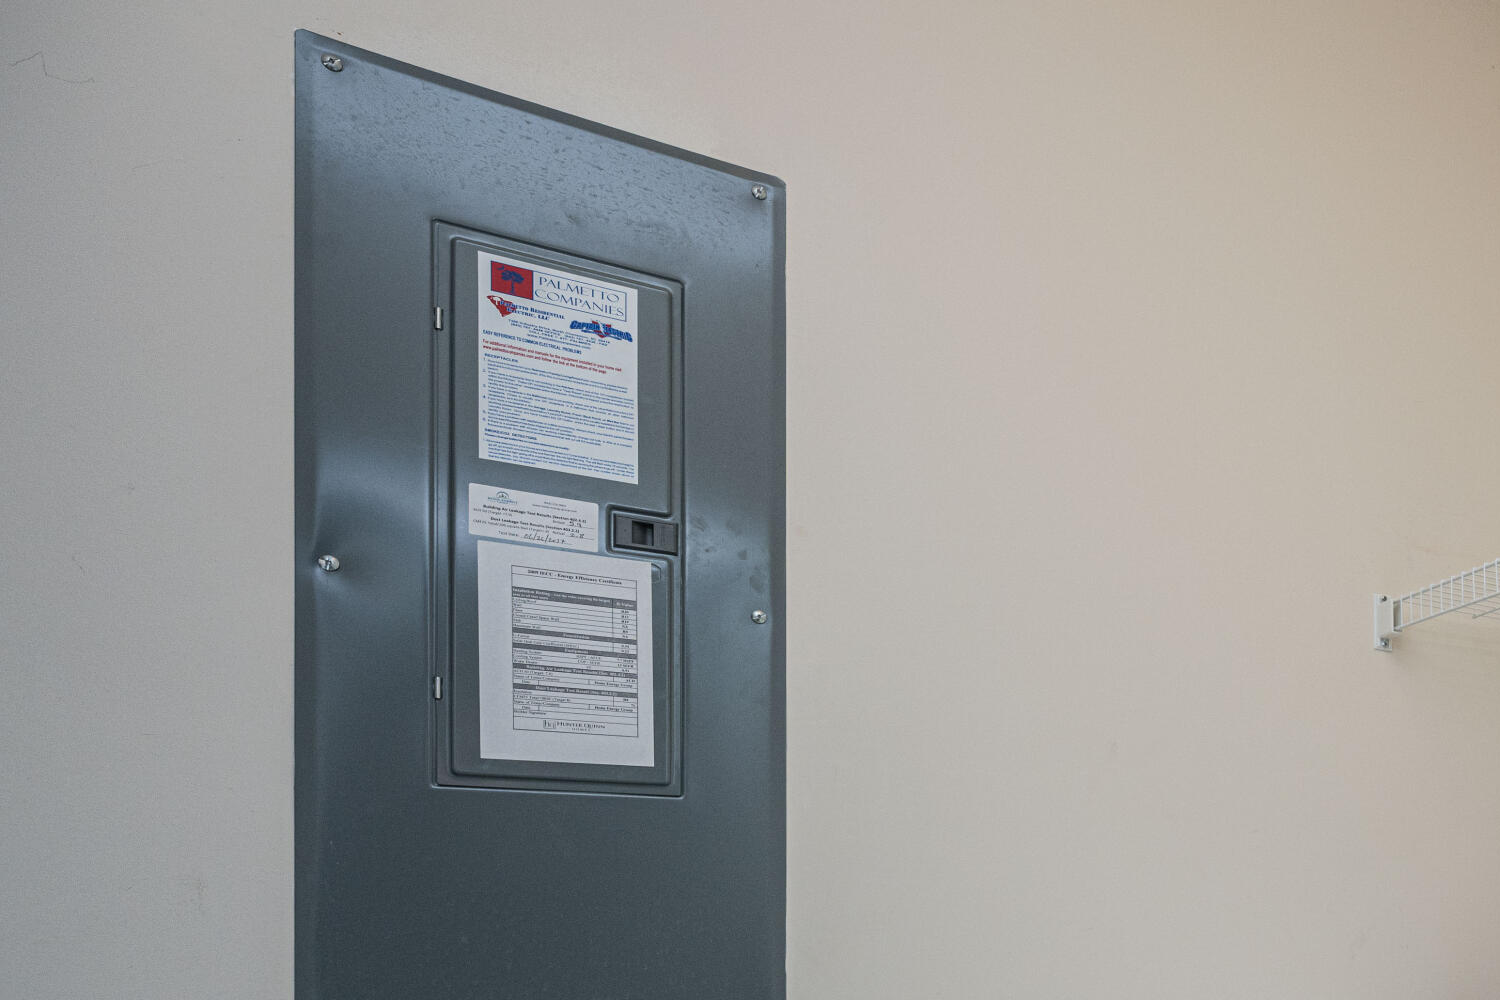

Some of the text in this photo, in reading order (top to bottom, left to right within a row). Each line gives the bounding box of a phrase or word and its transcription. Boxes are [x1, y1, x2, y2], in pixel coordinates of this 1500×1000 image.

[539, 276, 620, 302] PALMETTO
[534, 289, 625, 317] COMPANIES
[539, 340, 561, 350] ELECTRICAL
